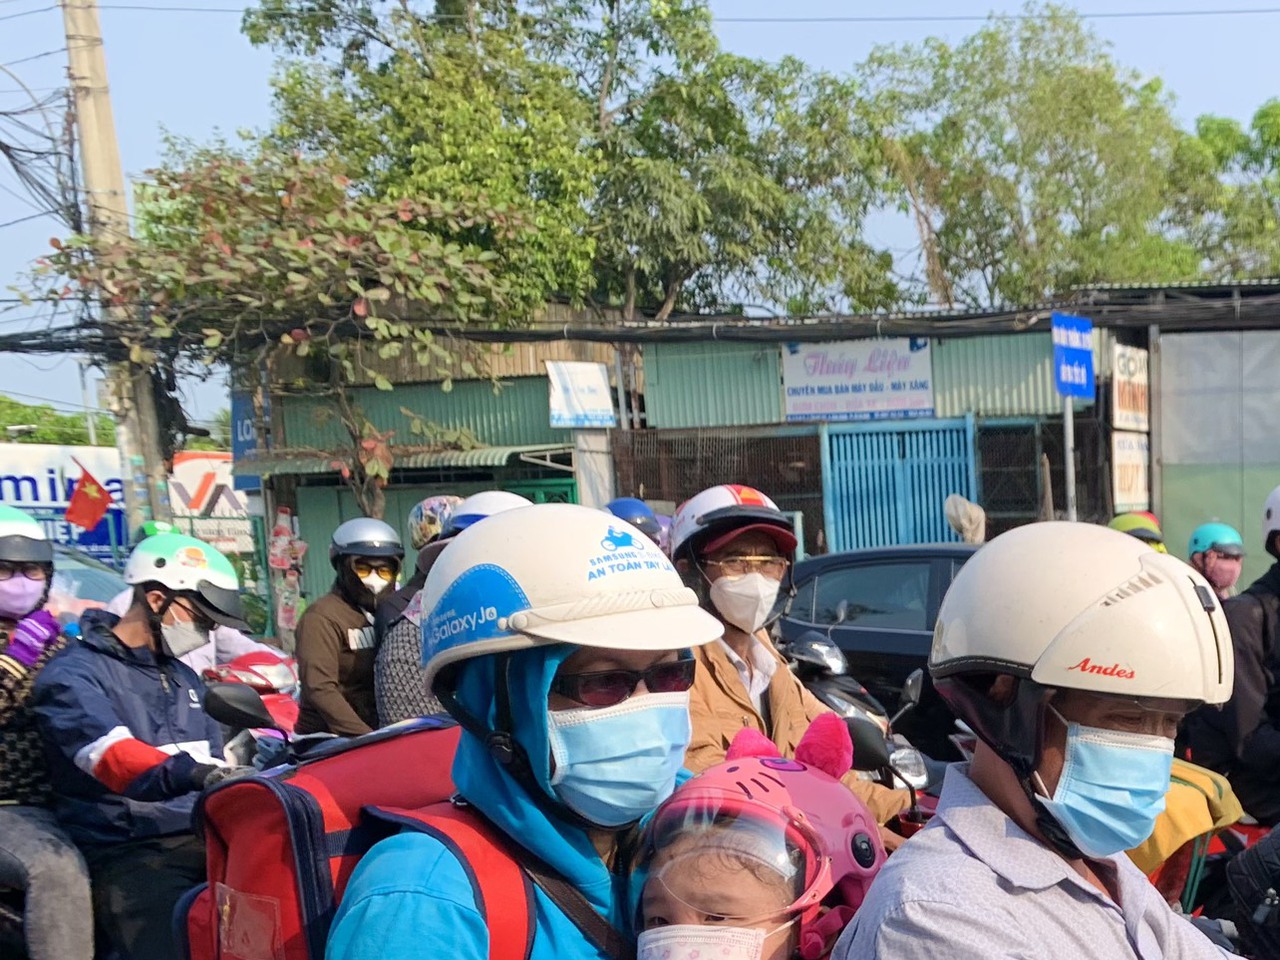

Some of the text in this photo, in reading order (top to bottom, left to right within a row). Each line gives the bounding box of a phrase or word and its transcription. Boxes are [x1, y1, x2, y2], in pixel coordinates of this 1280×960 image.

[589, 551, 637, 567] SAMSUNG
[587, 567, 607, 582] AN
[611, 559, 642, 575] TOÀN
[1067, 657, 1136, 679] Andes
